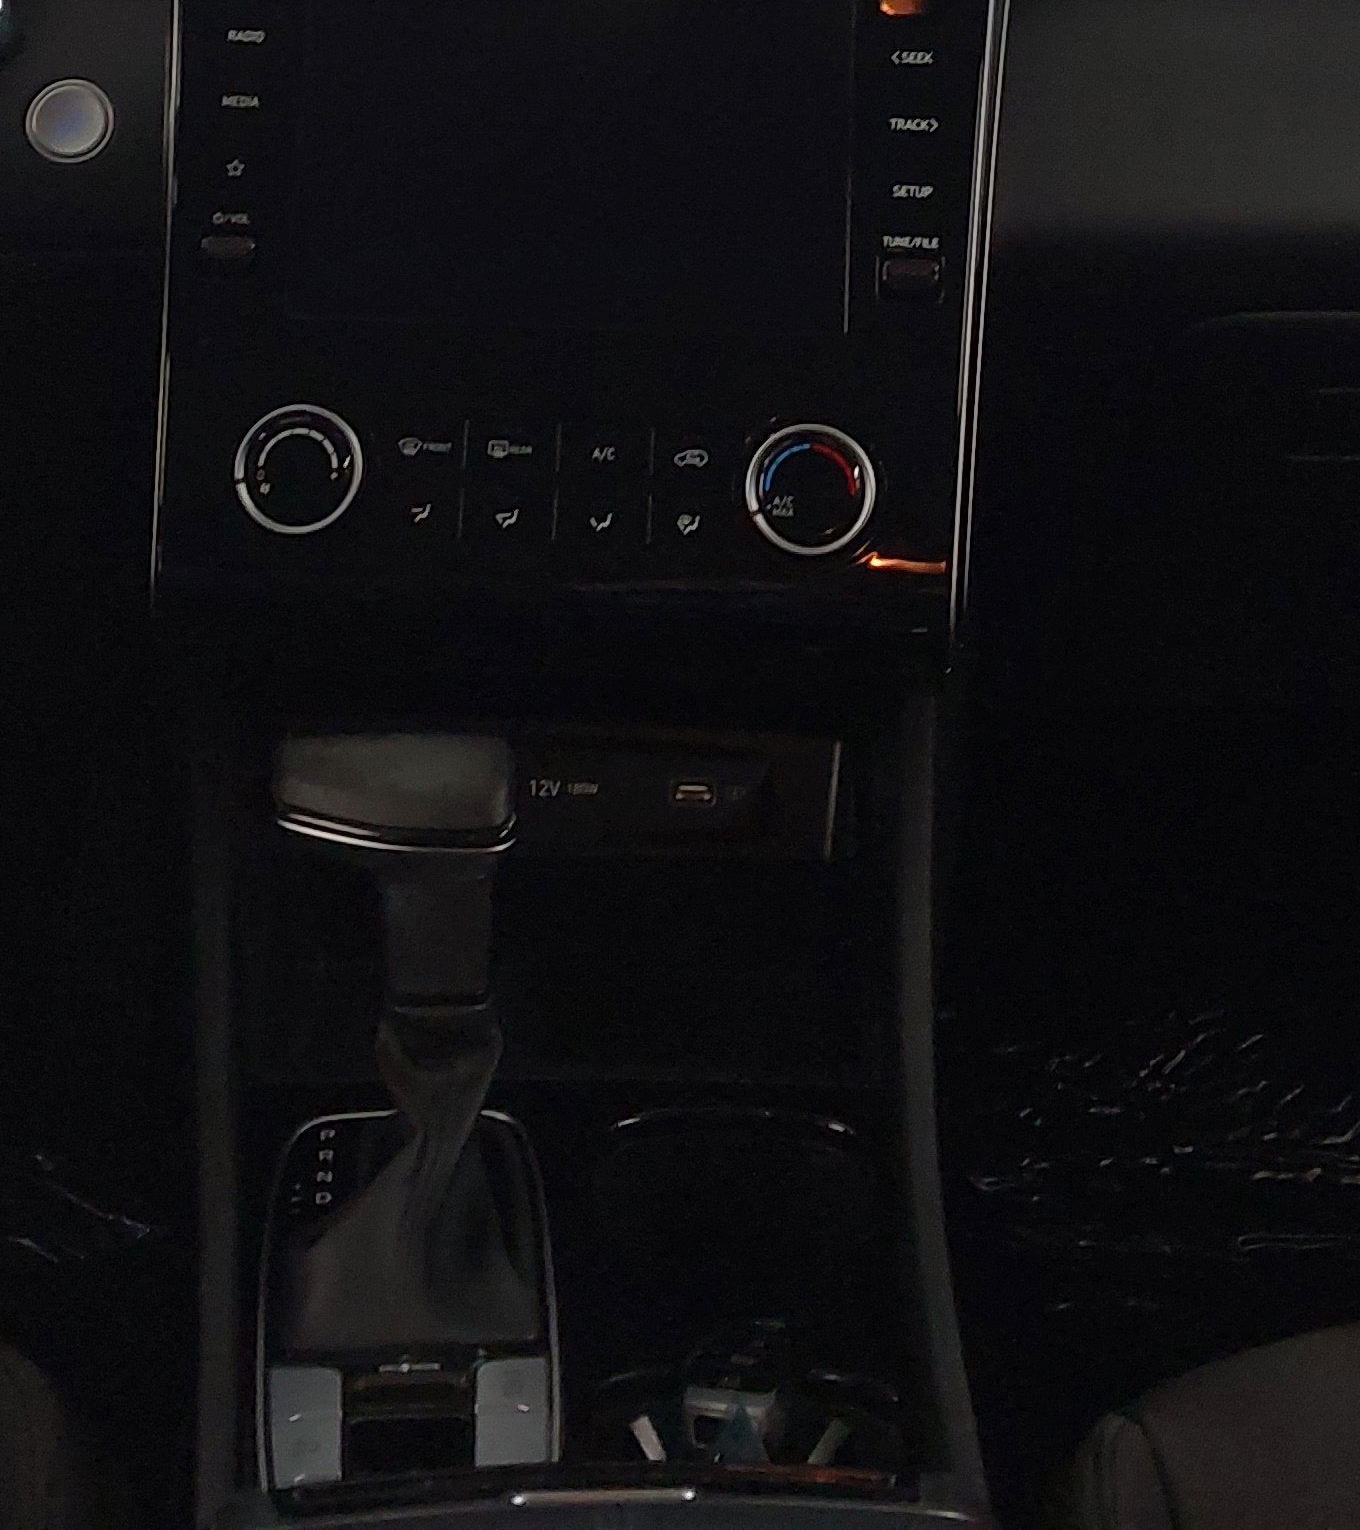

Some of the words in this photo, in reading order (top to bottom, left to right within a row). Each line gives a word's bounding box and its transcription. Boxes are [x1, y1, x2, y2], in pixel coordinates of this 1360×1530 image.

[220, 94, 260, 108] MEDIA
[891, 184, 935, 199] SETUP
[591, 445, 618, 462] A/C
[528, 778, 561, 797] 12V
